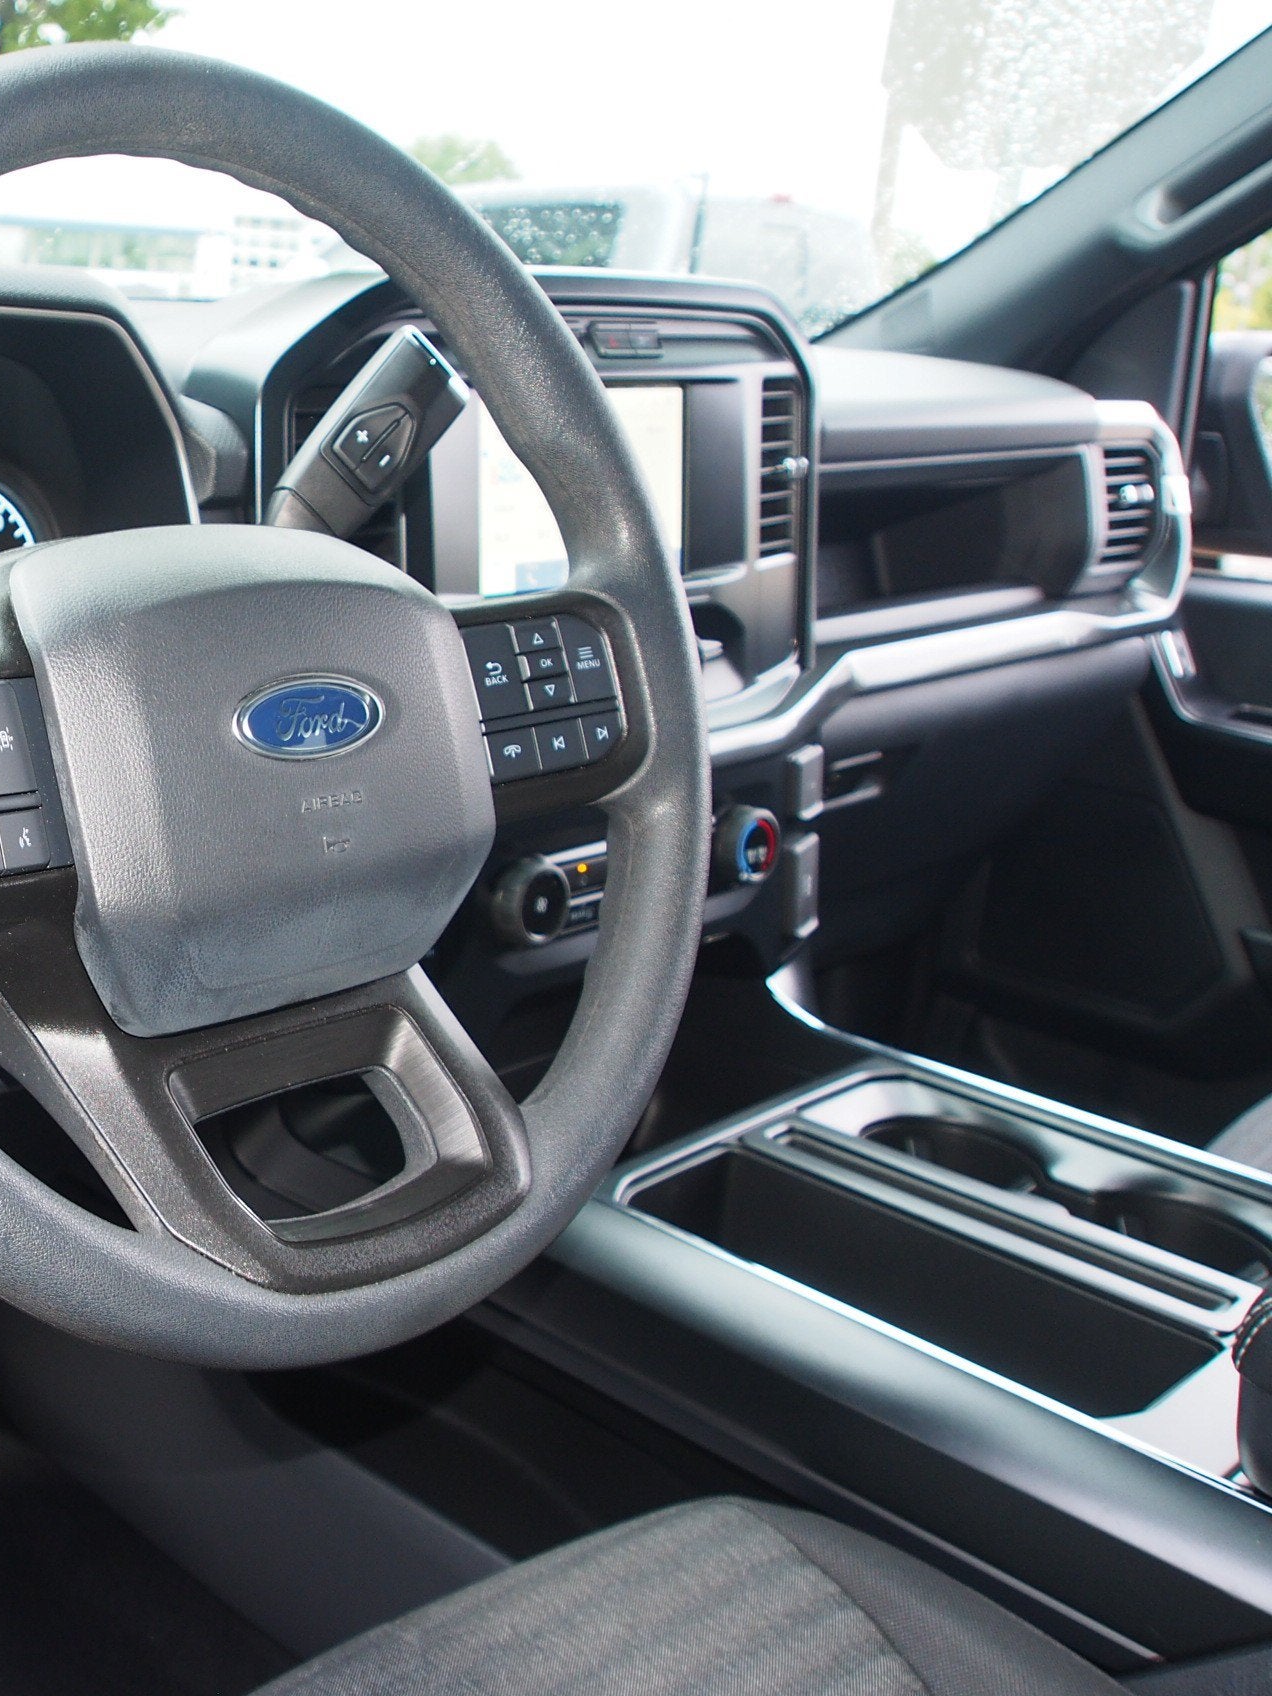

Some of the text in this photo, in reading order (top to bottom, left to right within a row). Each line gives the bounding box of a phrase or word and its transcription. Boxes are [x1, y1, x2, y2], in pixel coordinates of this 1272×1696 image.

[540, 657, 554, 668] OK
[577, 657, 601, 670] MENU
[485, 674, 509, 687] BACK
[277, 694, 363, 742] Ford
